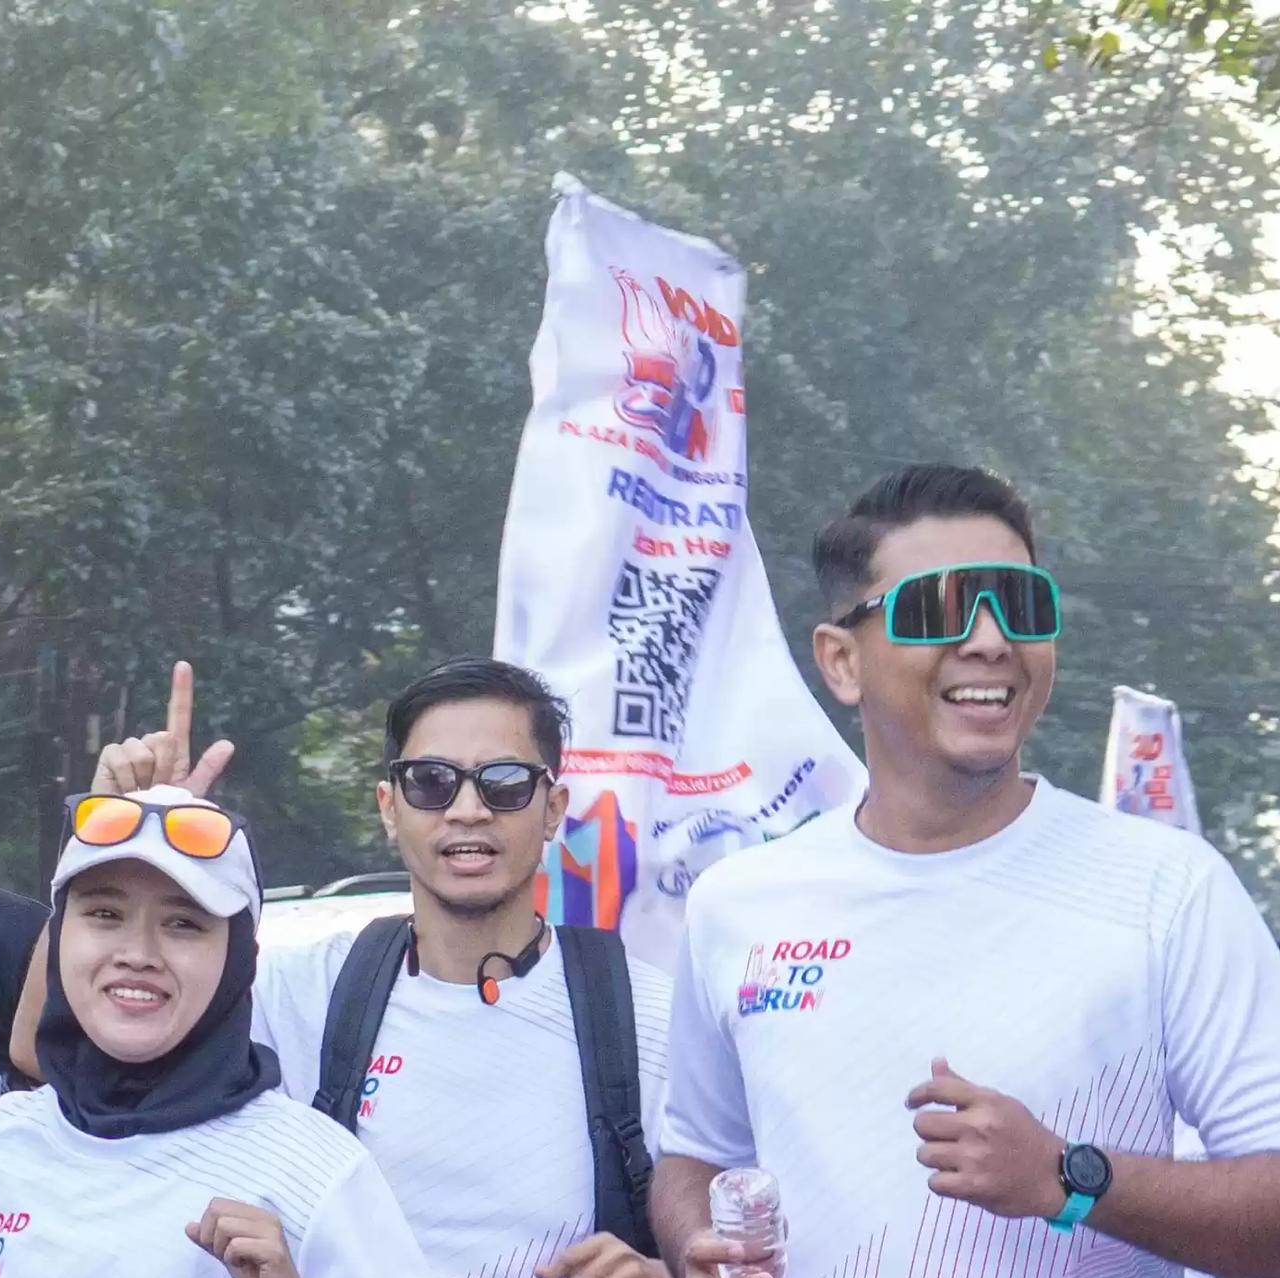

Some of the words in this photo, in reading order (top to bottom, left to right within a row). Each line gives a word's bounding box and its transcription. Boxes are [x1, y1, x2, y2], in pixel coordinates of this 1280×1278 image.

[772, 939, 851, 960] ROAD
[788, 965, 823, 985] TO
[765, 988, 818, 1010] RUN
[369, 1055, 403, 1074] AD
[362, 1078, 379, 1095] O
